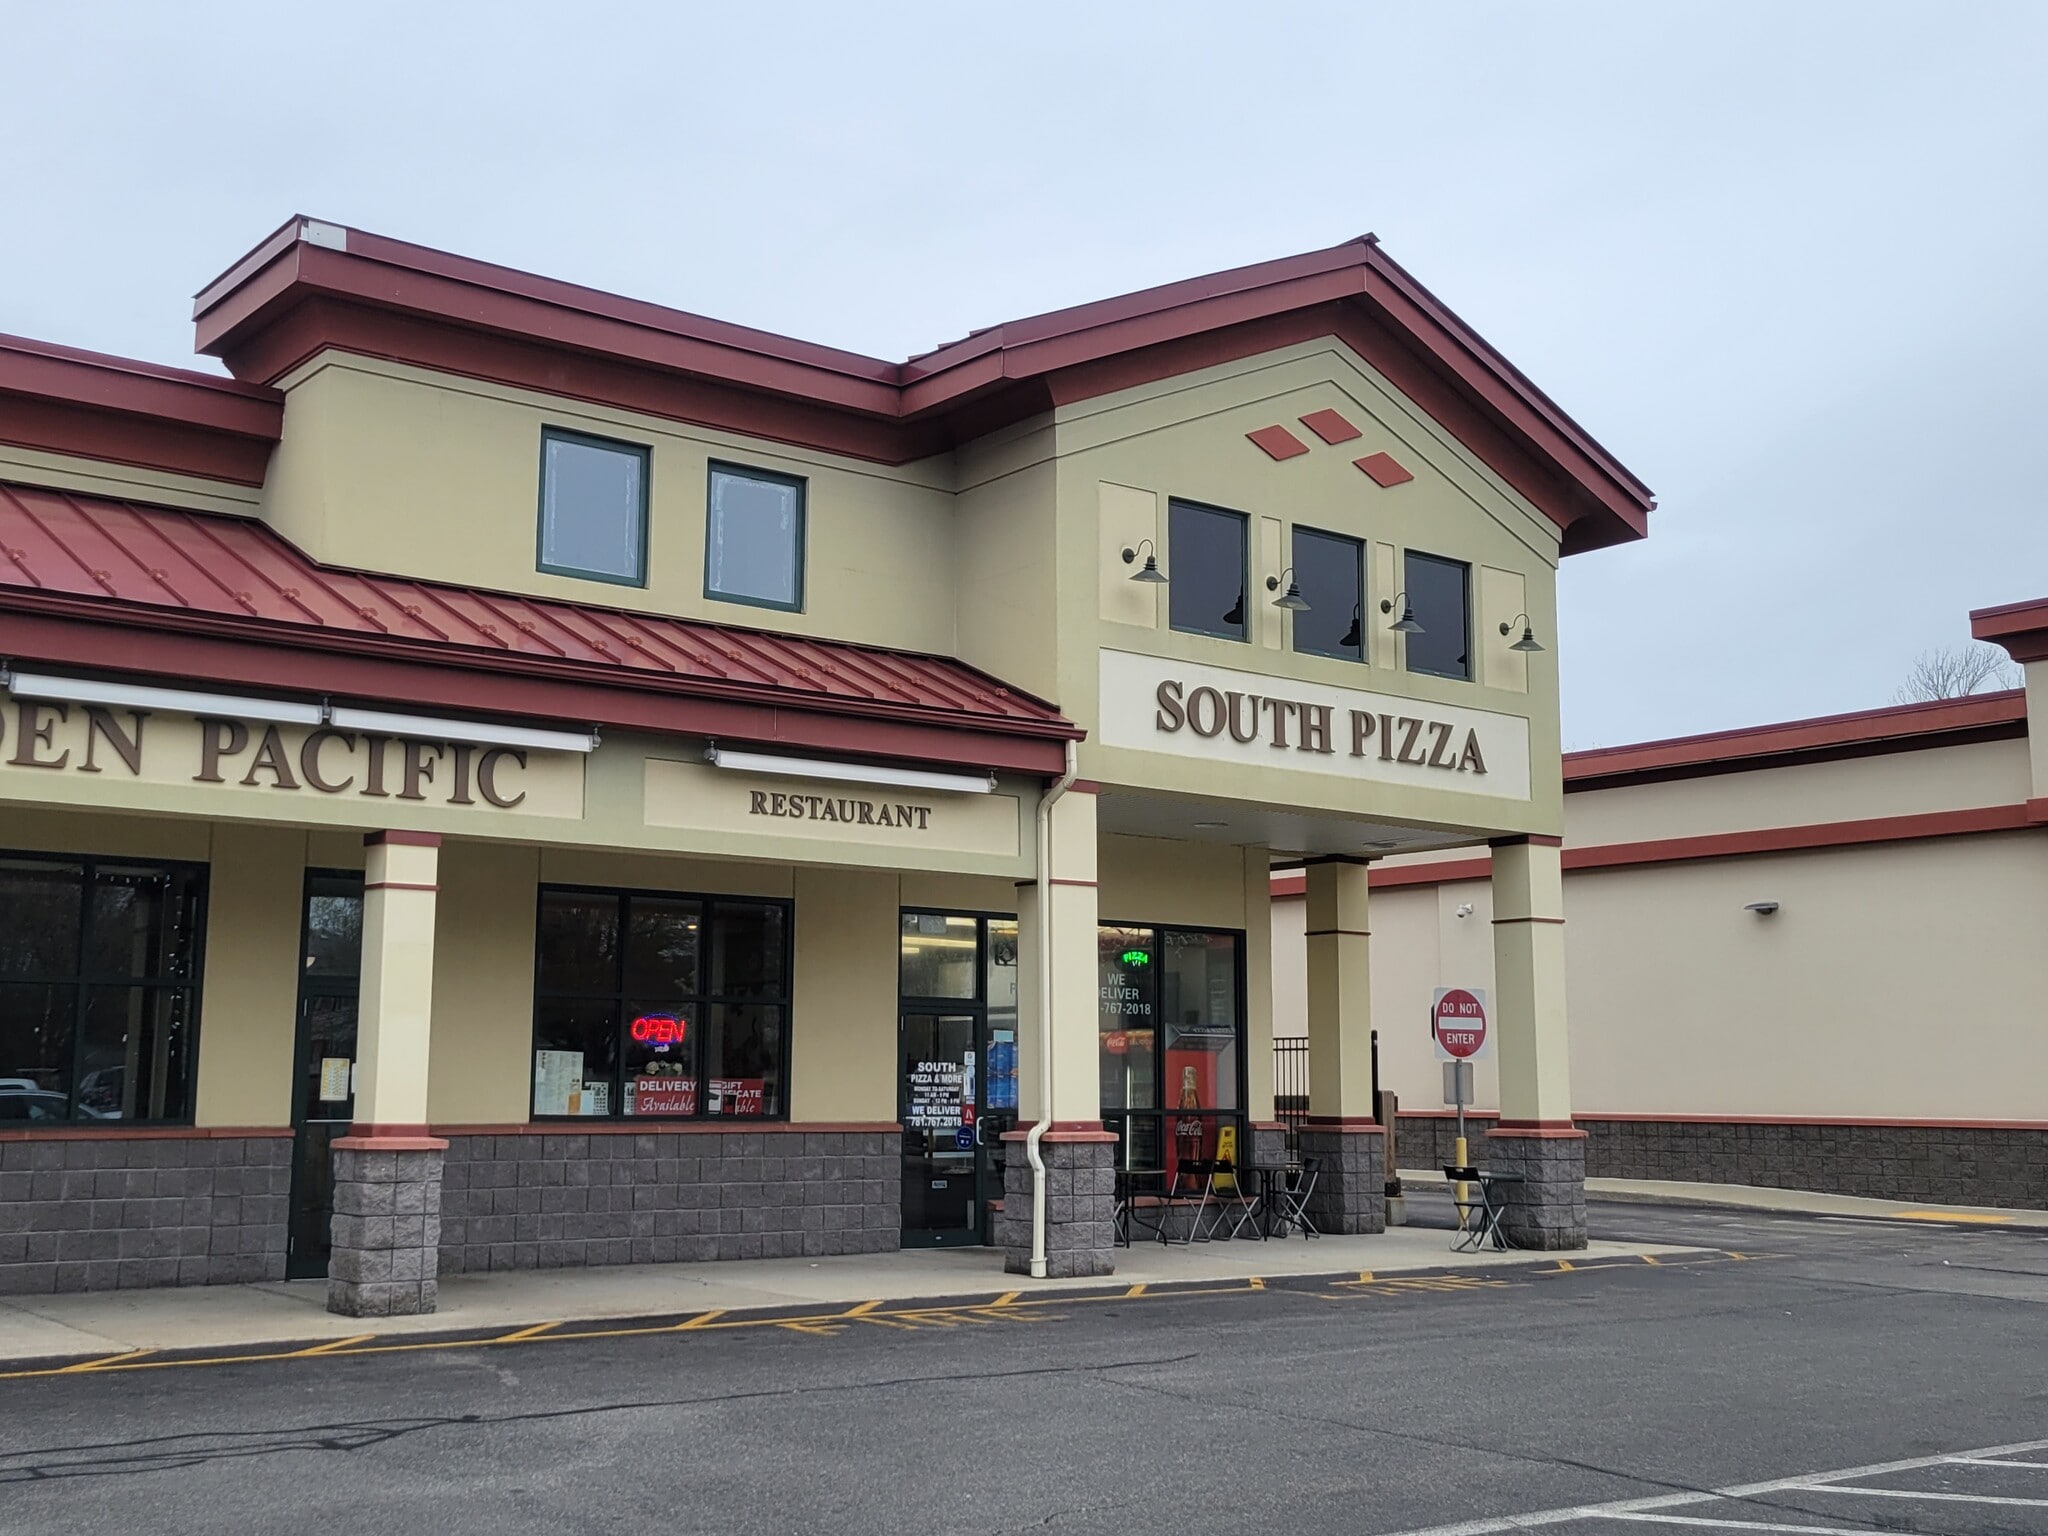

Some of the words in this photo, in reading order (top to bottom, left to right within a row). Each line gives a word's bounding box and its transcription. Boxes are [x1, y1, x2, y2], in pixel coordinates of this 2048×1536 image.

[1156, 680, 1336, 754] SOUTH
[1348, 709, 1488, 774] PIZZA
[0, 697, 152, 776] EN
[192, 716, 527, 808] PACIFIC
[749, 790, 931, 829] RESTAURANT
[1107, 973, 1126, 986] WE
[1100, 987, 1140, 1000] ELIVER
[1442, 1002, 1455, 1013] DO
[1459, 1003, 1478, 1014] NOT
[631, 1018, 686, 1043] OPEN
[1446, 1033, 1475, 1044] ENTER
[917, 1061, 956, 1073] SOUTH
[910, 1074, 933, 1083] PIZZA
[941, 1074, 963, 1084] MORE
[639, 1081, 697, 1092] DELIVERY
[640, 1095, 695, 1112] Available
[911, 1105, 925, 1115] WE
[926, 1105, 961, 1115] DELIVER
